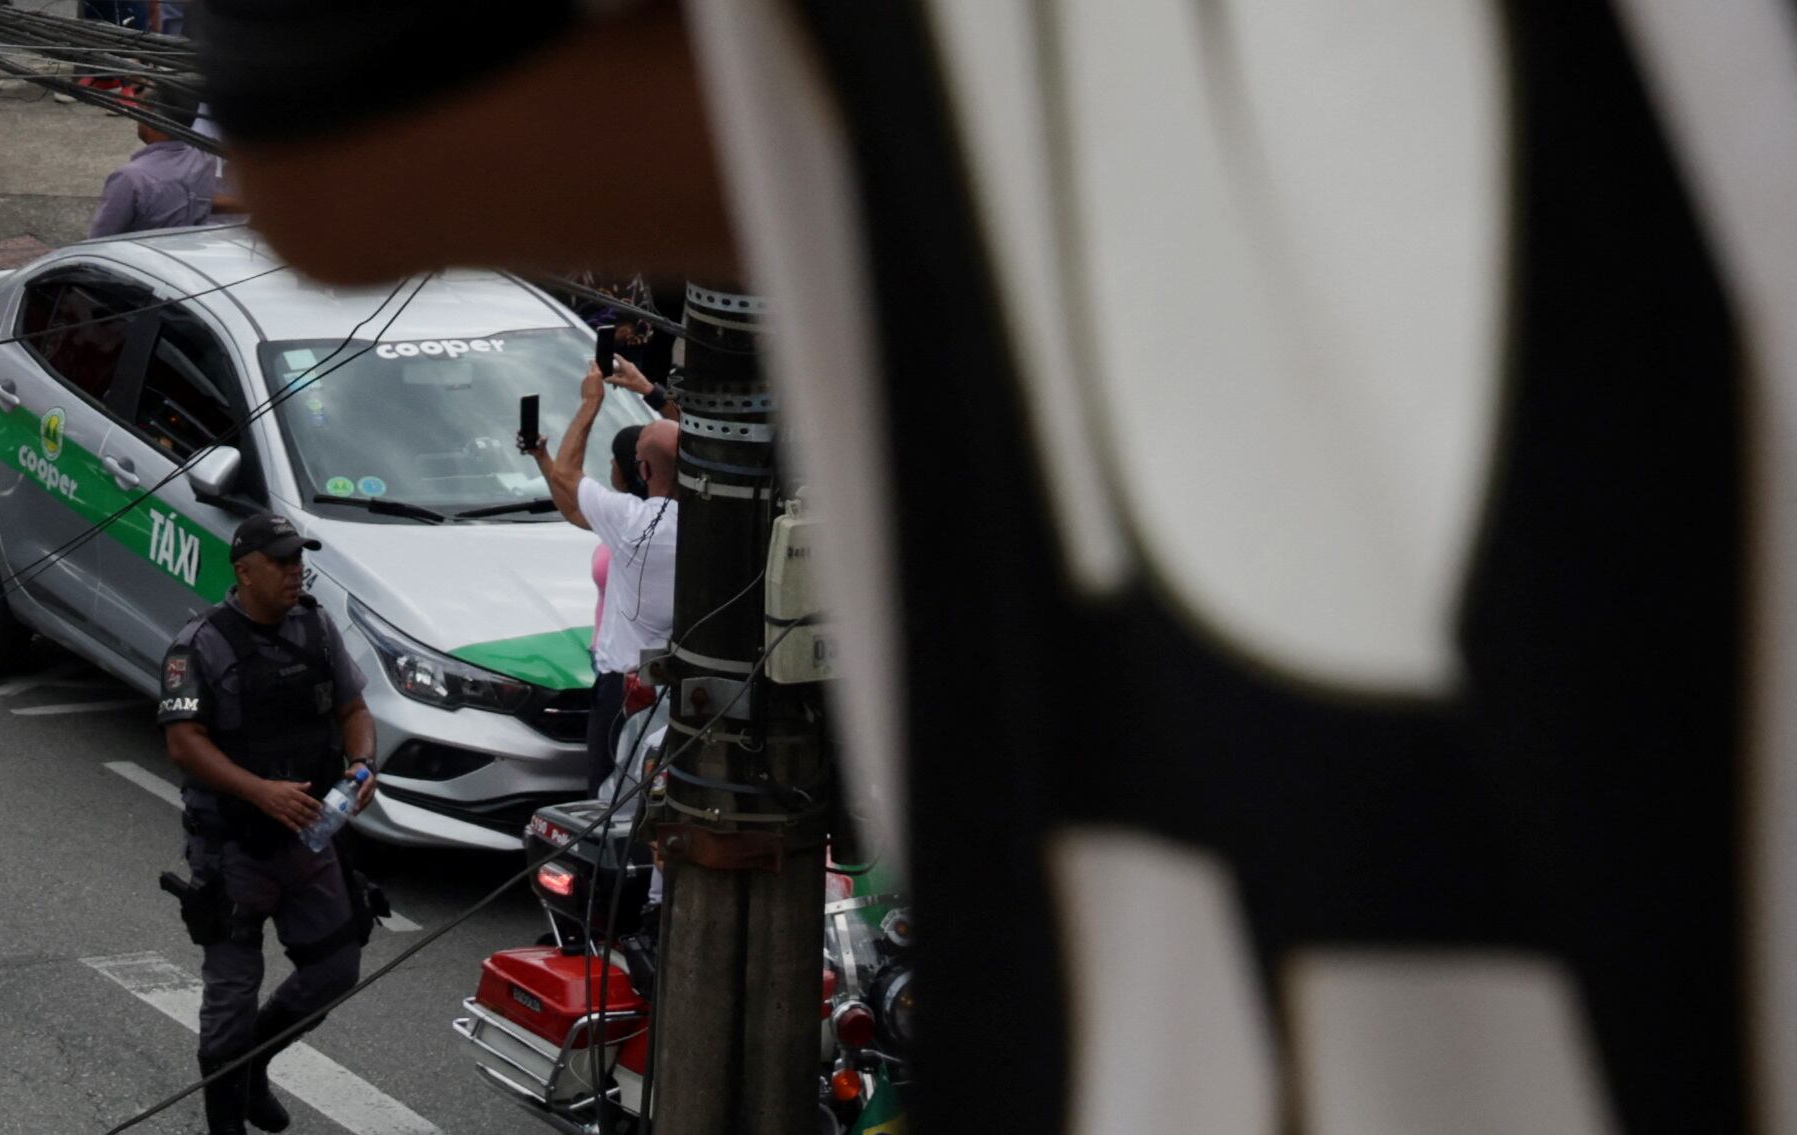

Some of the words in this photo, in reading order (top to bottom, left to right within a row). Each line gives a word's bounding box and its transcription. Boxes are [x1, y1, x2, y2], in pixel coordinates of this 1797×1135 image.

[376, 338, 504, 359] cooper
[18, 445, 78, 500] cooper
[149, 508, 200, 586] TÁXI
